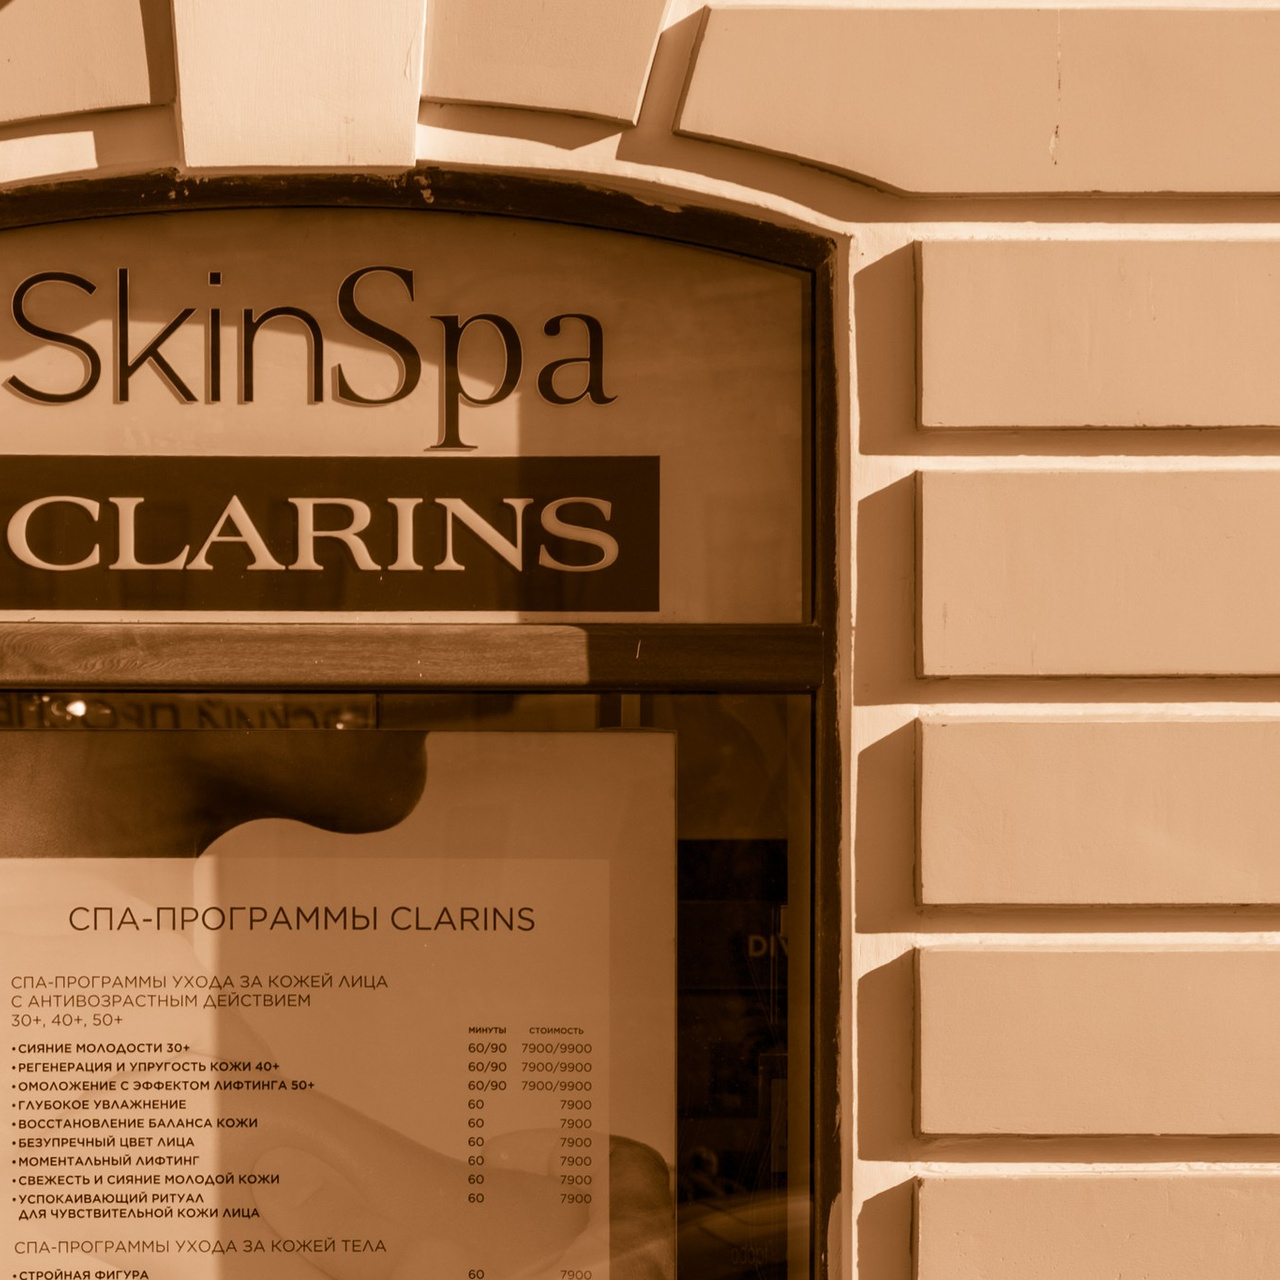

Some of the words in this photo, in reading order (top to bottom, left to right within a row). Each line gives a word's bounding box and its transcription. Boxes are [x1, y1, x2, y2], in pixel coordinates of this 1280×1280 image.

[4, 265, 618, 452] SkinSpa
[6, 495, 620, 573] CLARINS
[68, 905, 378, 932] СПА-ПРОГРАММЫ
[390, 905, 536, 932] CLARINS
[10, 975, 167, 990] СПА-ПРОГРАММЫ
[171, 974, 235, 991] УХОДА
[239, 974, 264, 989] ЗА
[268, 971, 333, 989] КОЖЕЙ
[337, 974, 389, 991] ЛИЦА
[10, 994, 23, 1009] С
[27, 993, 198, 1009] АНТИВОЗРАСТНЫМ
[202, 991, 311, 1010] ДЕЙСТВИЕМ
[10, 1013, 46, 1029] 30+,
[50, 1012, 88, 1029] 40+,
[92, 1012, 124, 1027] 50+
[467, 1026, 507, 1035] МИНУТЫ
[528, 1026, 585, 1036] СТОИМОСТЬ
[17, 1042, 73, 1055] СИЯНИЕ
[75, 1042, 163, 1056] МОЛОДОСТИ
[166, 1042, 192, 1055] 30+
[467, 1041, 508, 1055] 60/90
[521, 1042, 593, 1055] 7900/9900
[17, 1061, 113, 1075] РЕГЕНЕРАЦИЯ
[116, 1061, 126, 1073] И
[129, 1061, 208, 1073] УПРУГОСТЬ
[209, 1060, 253, 1073] КОЖИ
[254, 1060, 280, 1073] 40+
[467, 1060, 508, 1074] 60/90
[521, 1060, 593, 1075] 7900/9900
[17, 1079, 118, 1094] ОМОЛОЖЕНИЕ
[119, 1080, 130, 1092] С
[132, 1079, 211, 1092] ЭФФЕКТОМ
[213, 1079, 288, 1091] ЛИФТИНГА
[290, 1079, 316, 1091] 50+
[467, 1079, 508, 1093] 60/90
[521, 1079, 593, 1093] 7900/9900
[17, 1098, 90, 1111] ГЛУБОКОЕ
[92, 1098, 187, 1111] УВЛАЖНЕНИЕ
[467, 1098, 485, 1110] 60
[559, 1099, 593, 1111] 7900
[18, 1117, 145, 1130] ВОССТАНОВЛЕНИЕ
[148, 1117, 214, 1129] БАЛАНСА
[216, 1117, 259, 1129] КОЖИ
[467, 1117, 485, 1129] 60
[559, 1117, 593, 1130] 7900
[18, 1134, 116, 1149] БЕЗУПРЕЧНЫЙ
[119, 1136, 154, 1150] ЦВЕТ
[156, 1136, 196, 1150] ЛИЦА
[467, 1136, 485, 1148] 60
[559, 1136, 593, 1148] 7900
[18, 1153, 132, 1168] МОМЕНТАЛЬНЫЙ
[134, 1155, 201, 1167] ЛИФТИНГ
[467, 1154, 485, 1167] 60
[559, 1155, 593, 1167] 7900
[18, 1174, 91, 1187] СВЕЖЕСТЬ
[93, 1174, 104, 1186] И
[106, 1174, 162, 1186] СИЯНИЕ
[164, 1171, 235, 1187] МОЛОДОЙ
[238, 1171, 280, 1185] КОЖИ
[467, 1173, 485, 1185] 60
[559, 1174, 593, 1186] 7900
[18, 1190, 148, 1206] УСПОКАИВАЮЩИЙ
[151, 1192, 205, 1204] РИТУАЛ
[467, 1192, 485, 1204] 60
[559, 1193, 593, 1205] 7900
[17, 1208, 47, 1222] ДЛЯ
[50, 1206, 174, 1220] ЧУВСТВИТЕЛЬНОЙ
[176, 1207, 219, 1219] КОЖИ
[221, 1207, 261, 1220] ЛИЦА
[13, 1239, 170, 1255] СПА-ПРОГРАММЫ
[174, 1239, 238, 1256] УХОДА
[242, 1239, 266, 1254] ЗА
[270, 1236, 336, 1255] КОЖЕЙ
[340, 1238, 388, 1253] ТЕЛА
[94, 1269, 150, 1280] ФИГУРА
[467, 1268, 485, 1280] 60
[560, 1269, 593, 1280] 7900
